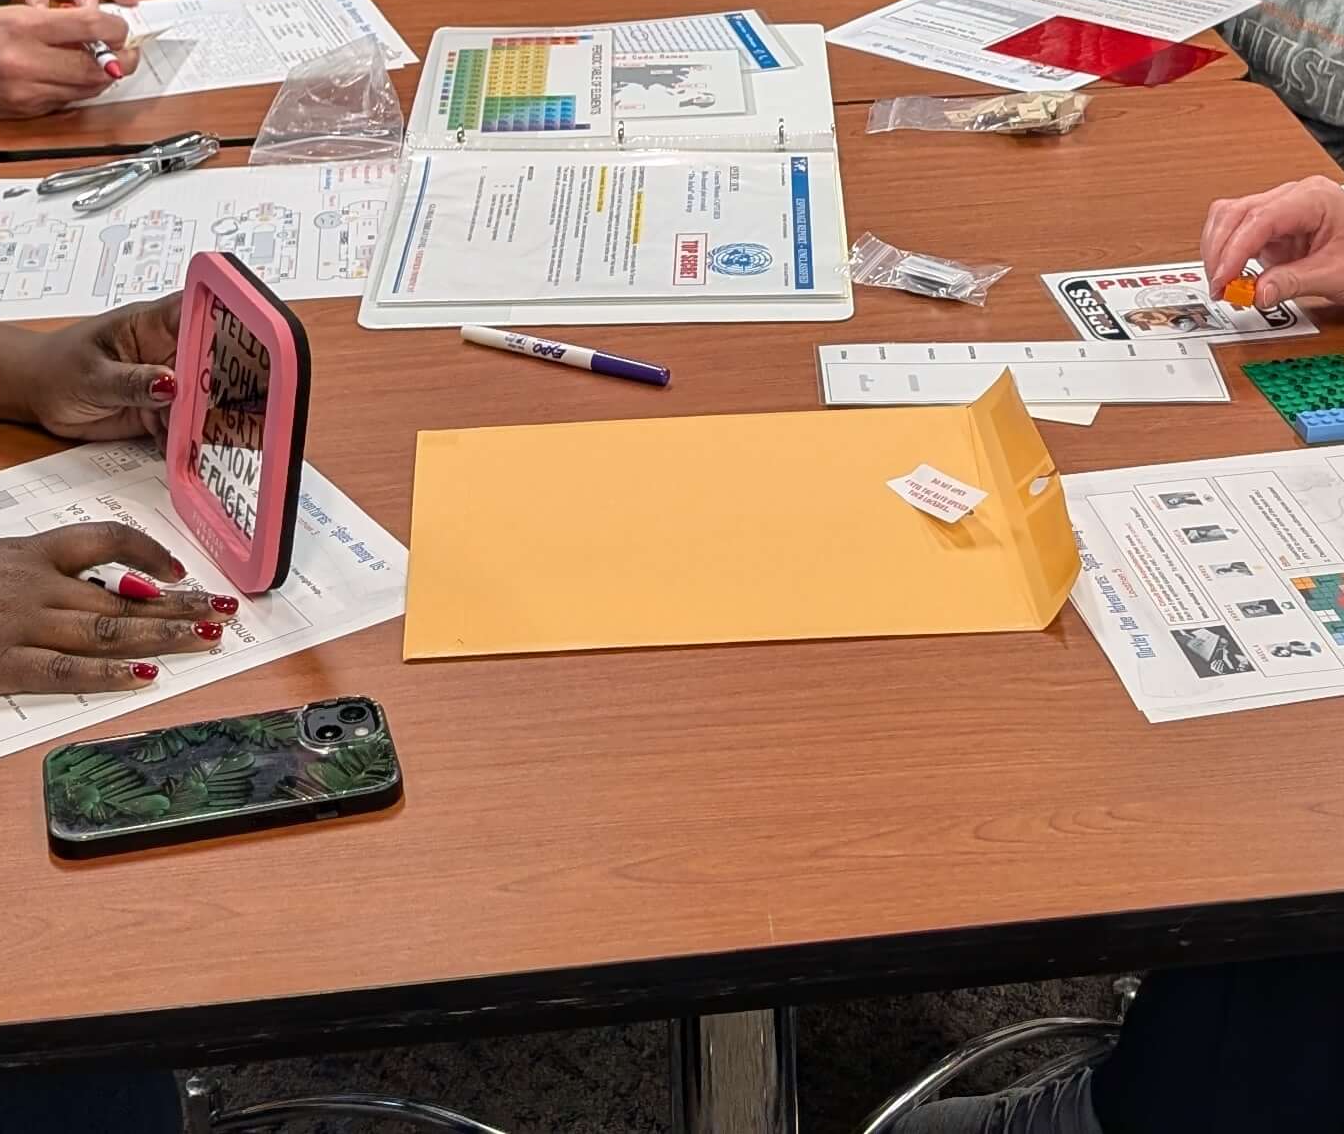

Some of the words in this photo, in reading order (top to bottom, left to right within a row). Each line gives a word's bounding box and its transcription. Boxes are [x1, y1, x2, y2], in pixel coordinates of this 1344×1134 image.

[591, 44, 602, 65] PERIODIC
[591, 66, 602, 81] TABLE
[589, 88, 601, 114] ELEMENTS
[795, 198, 808, 224] ESPIONAGE
[796, 224, 808, 244] REPORT
[681, 240, 699, 254] TOP
[680, 255, 699, 279] SECRET
[797, 248, 809, 284] UNCLASSIFIED
[1095, 273, 1203, 290] PRESS
[1070, 287, 1120, 334] PRESS
[532, 341, 567, 359] EXPO
[207, 333, 260, 406] ALOHA
[202, 408, 258, 486] LEMON
[188, 440, 256, 539] REFUGEE
[952, 486, 967, 496] OPEN
[1115, 573, 1137, 598] Location
[1120, 615, 1139, 631] Clue
[1130, 633, 1156, 659] Motley
